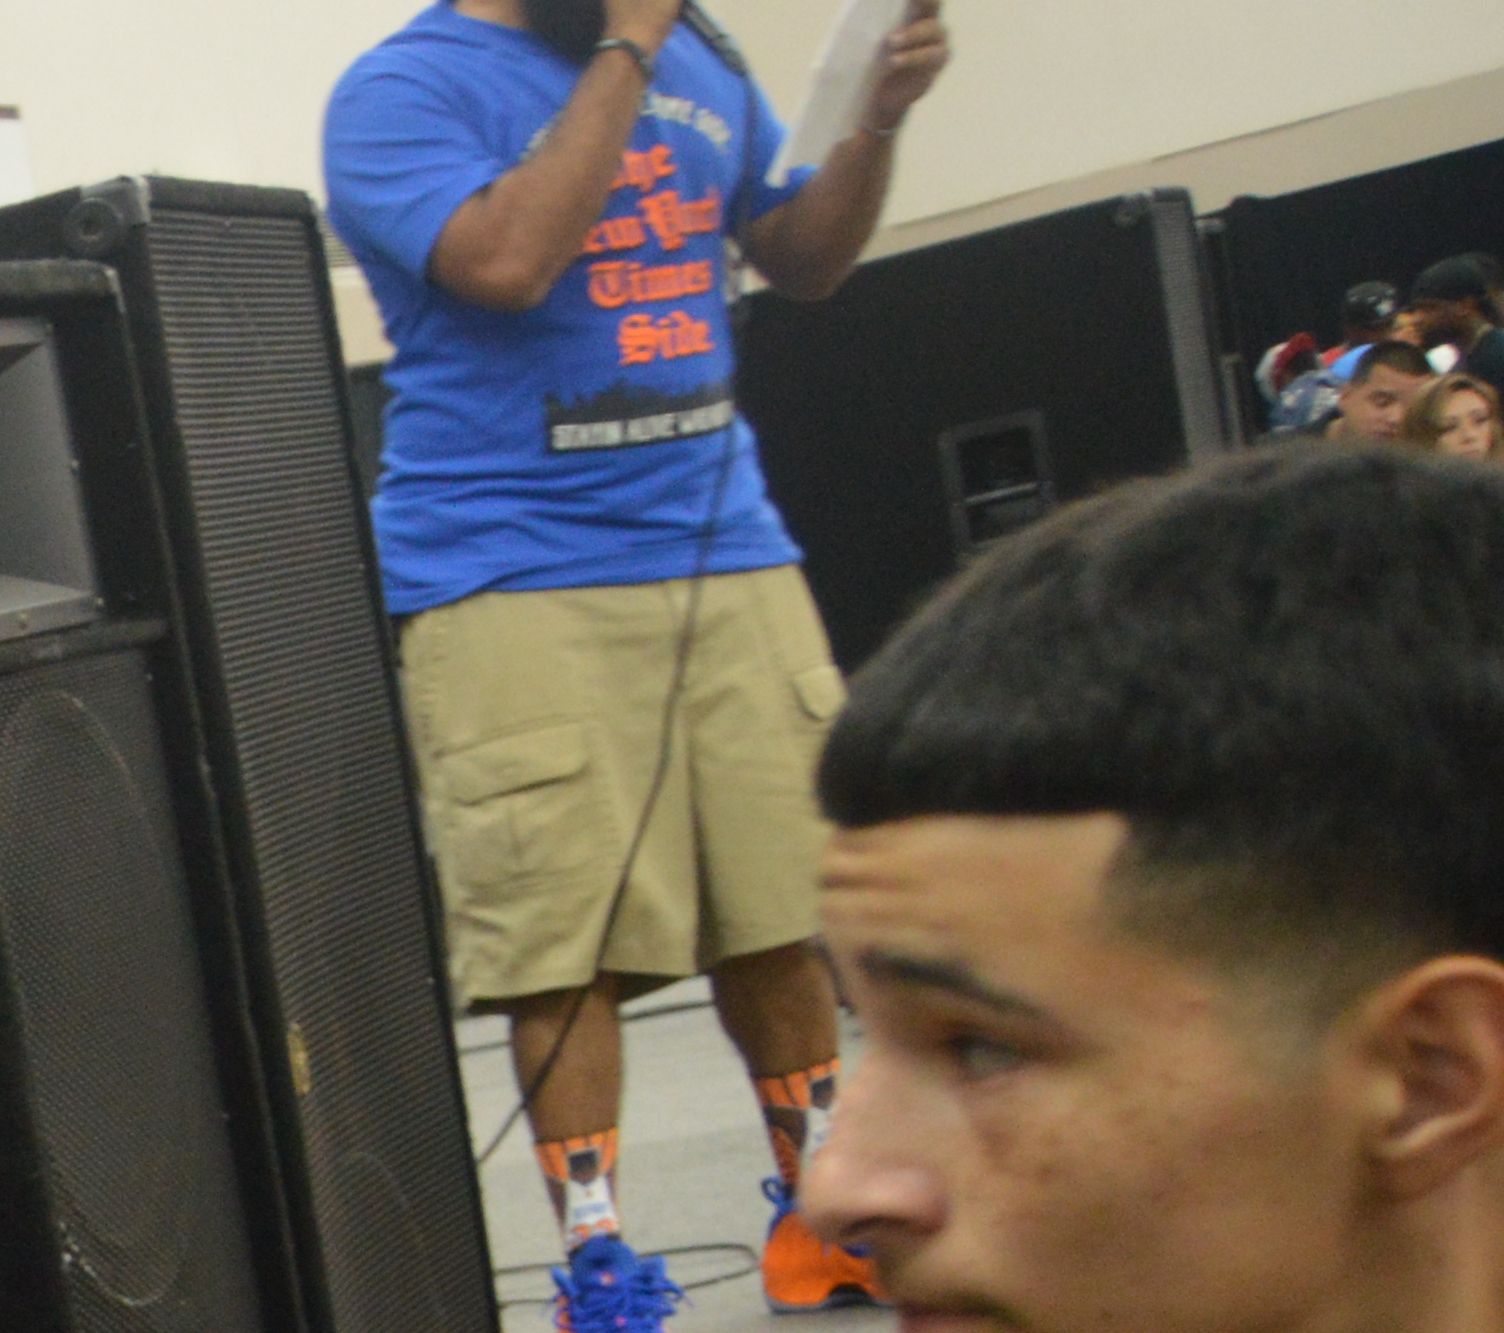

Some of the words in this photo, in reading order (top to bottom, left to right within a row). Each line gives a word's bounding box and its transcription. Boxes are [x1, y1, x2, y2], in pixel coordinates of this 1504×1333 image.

[582, 216, 646, 253] ew
[587, 259, 713, 308] Times
[618, 310, 715, 366] Side
